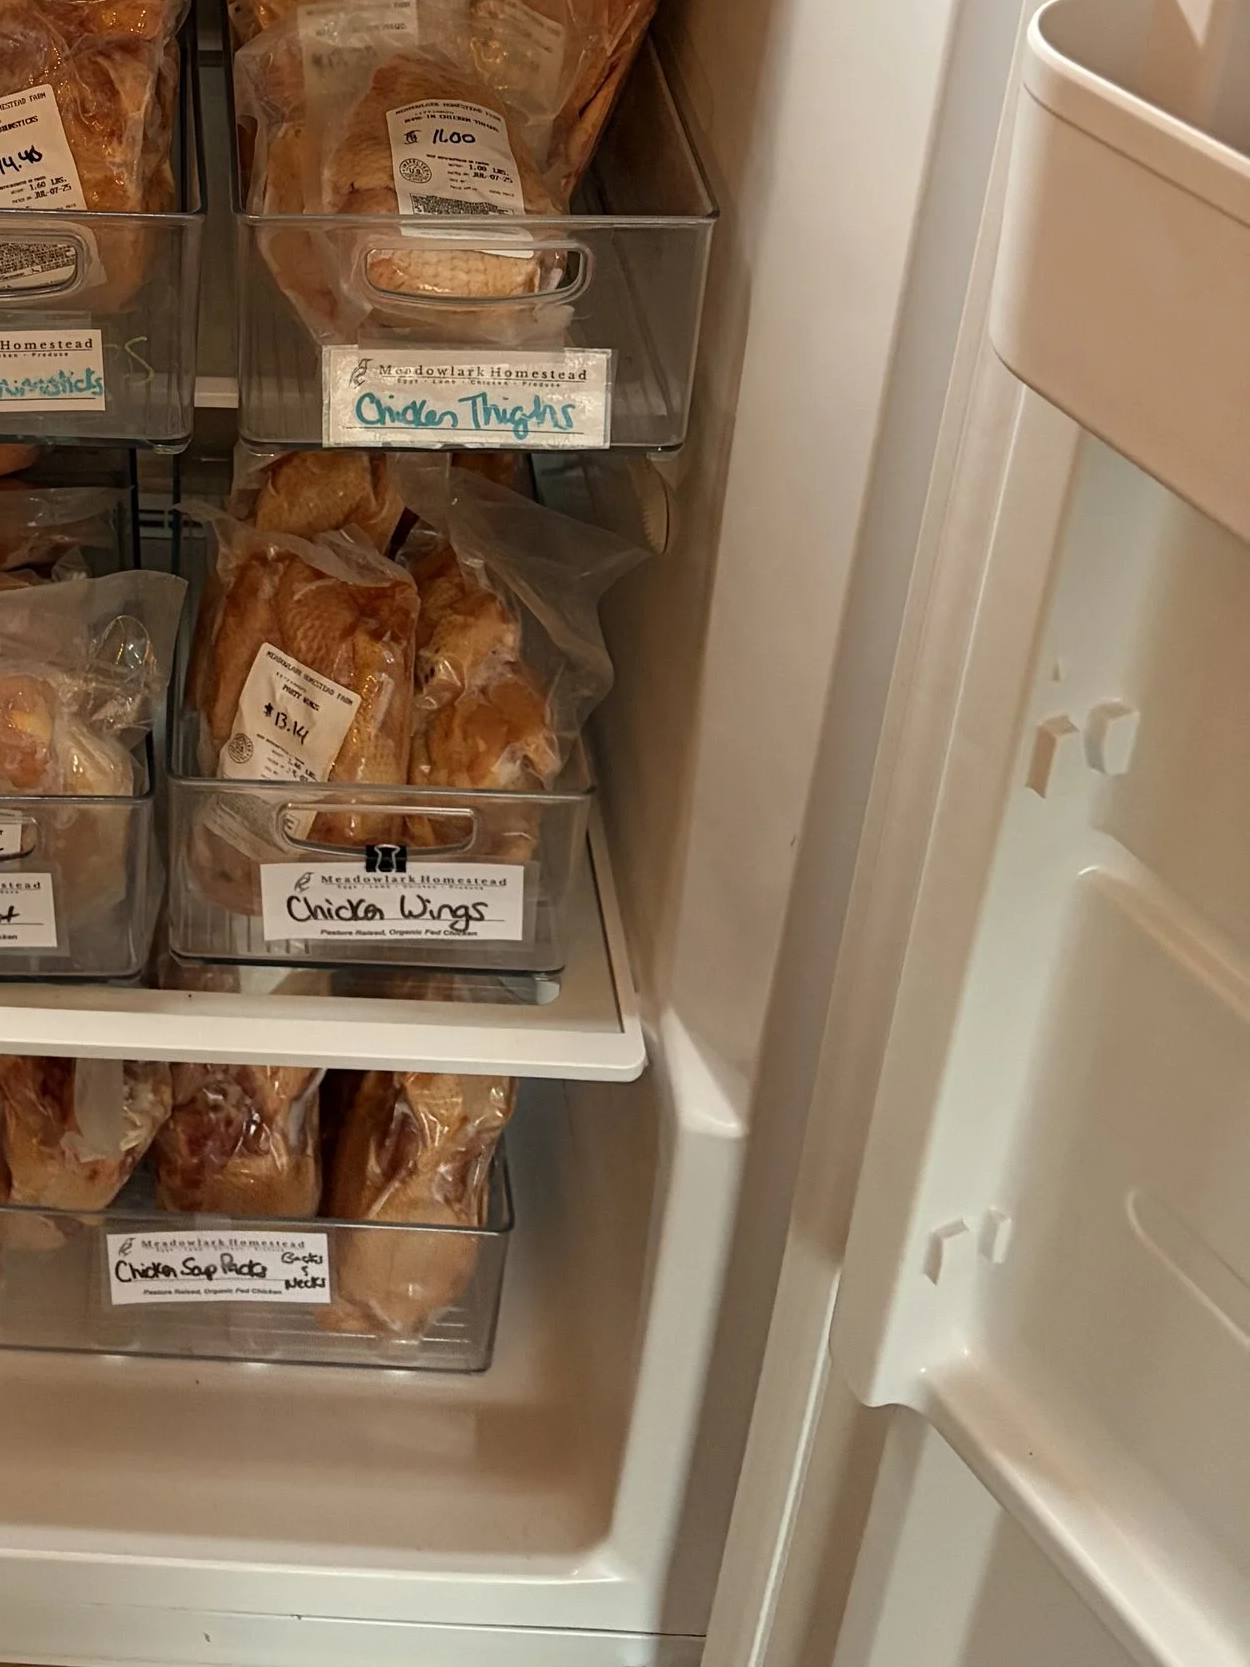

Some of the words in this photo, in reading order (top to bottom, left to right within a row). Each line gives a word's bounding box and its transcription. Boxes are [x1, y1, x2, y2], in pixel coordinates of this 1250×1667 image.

[0, 338, 94, 351] Homestead
[378, 364, 485, 377] Meadowlark
[490, 366, 587, 381] Homestead
[355, 391, 459, 428] Chicken
[458, 391, 576, 440] Thighs
[321, 874, 415, 884] Meadowlark
[420, 875, 507, 886] Homestead
[287, 895, 384, 922] Chicken
[400, 894, 488, 932] Wings
[141, 1238, 224, 1249] Meadowlark
[115, 1260, 177, 1282] Chicken
[284, 1276, 326, 1290] Necks
